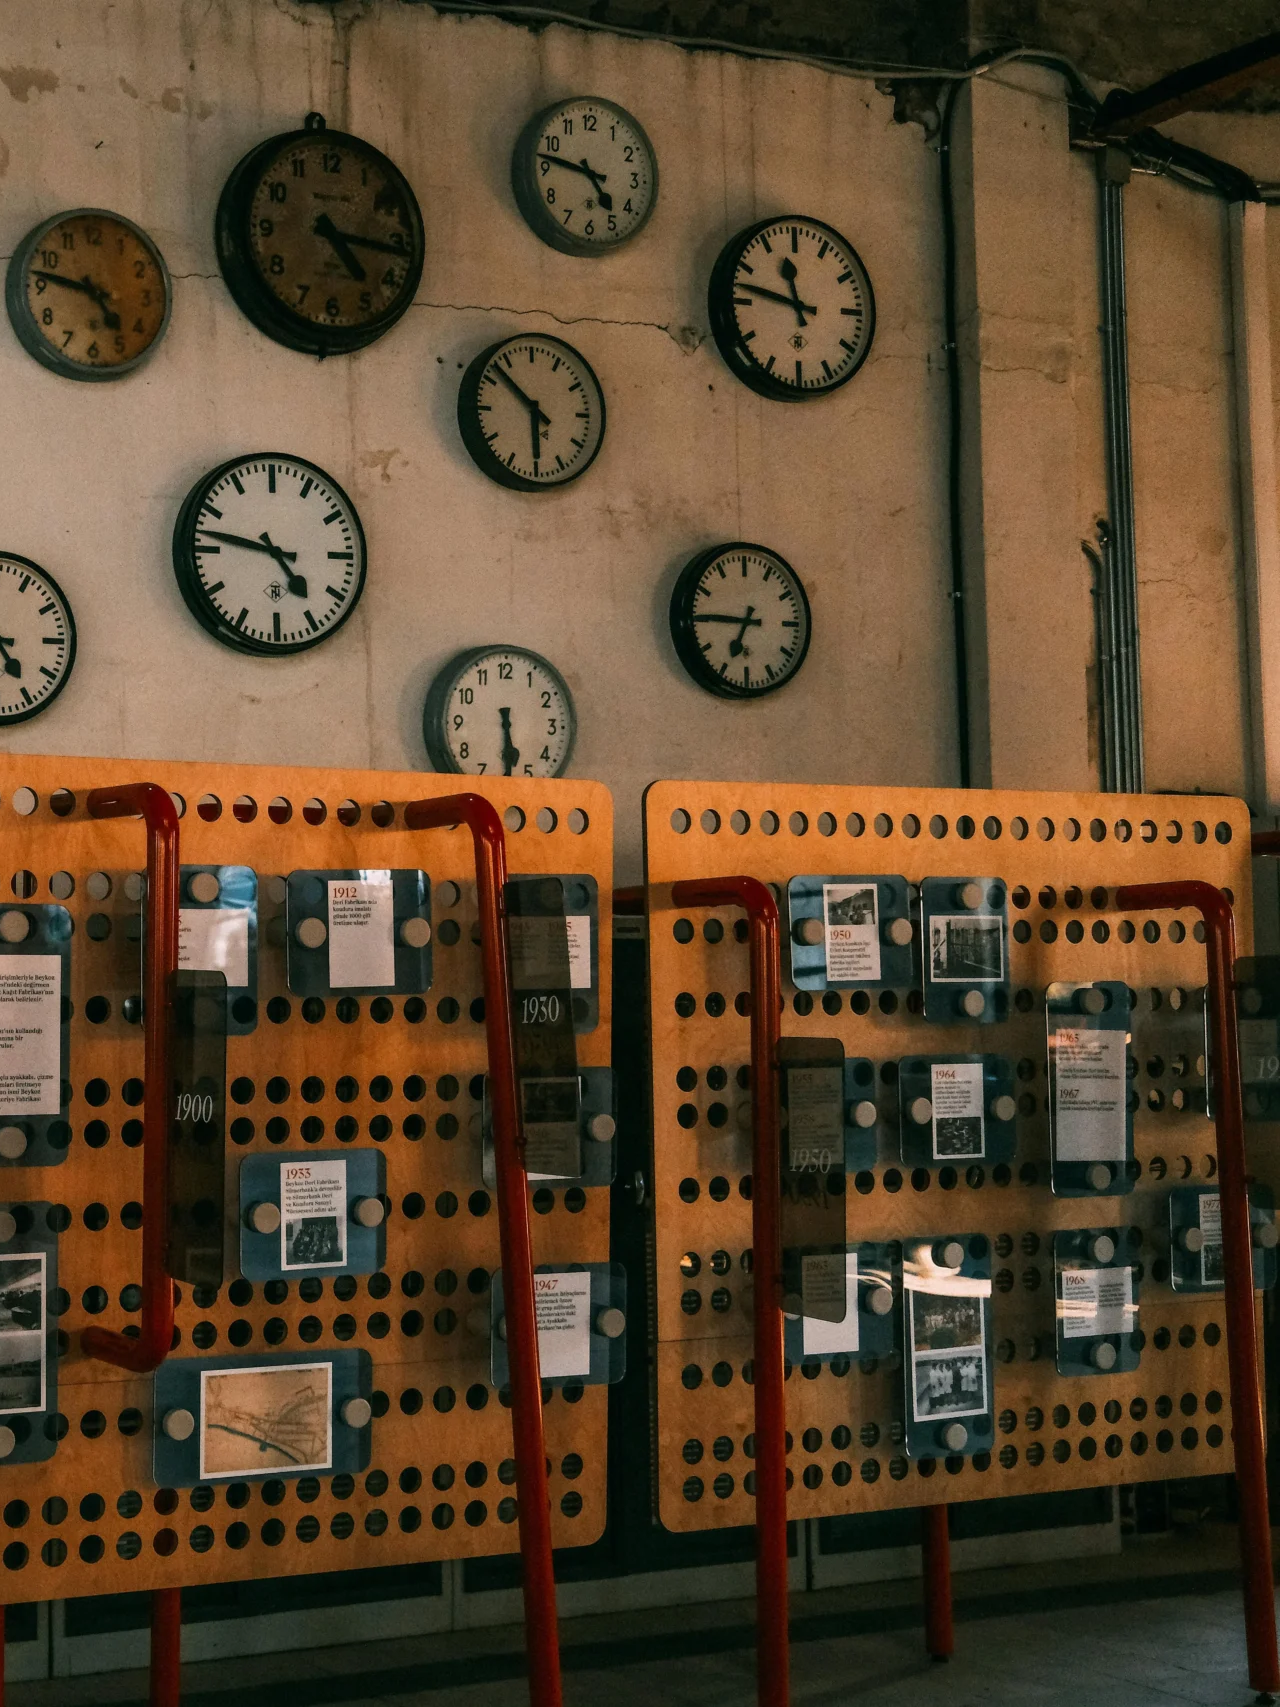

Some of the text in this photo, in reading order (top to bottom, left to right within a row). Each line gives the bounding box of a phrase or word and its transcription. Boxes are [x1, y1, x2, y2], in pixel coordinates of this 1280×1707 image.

[563, 119, 573, 135] 11
[583, 115, 597, 131] 12
[610, 126, 615, 141] 1
[545, 136, 559, 152] 10
[624, 146, 633, 162] 2
[292, 159, 305, 177] 11
[322, 153, 341, 173] 12
[541, 161, 550, 176] 9
[630, 173, 638, 189] 3
[269, 182, 286, 203] 10
[547, 188, 555, 204] 8
[623, 199, 632, 214] 4
[564, 210, 572, 224] 7
[608, 215, 616, 231] 5
[260, 219, 273, 237] 9
[585, 220, 594, 235] 6
[62, 233, 73, 249] 11
[42, 251, 58, 269] 10
[271, 255, 284, 275] 8
[133, 261, 145, 279] 2
[381, 268, 395, 287] 4
[36, 279, 46, 295] 9
[297, 285, 310, 304] 7
[326, 298, 339, 317] 6
[43, 308, 53, 325] 8
[63, 331, 73, 347] 7
[87, 342, 99, 358] 6
[477, 669, 487, 685] 11
[498, 663, 512, 679] 12
[527, 672, 531, 688] 1
[459, 688, 473, 704] 10
[541, 691, 551, 708] 2
[454, 715, 463, 731] 9
[548, 719, 557, 735] 3
[460, 742, 469, 759] 8
[540, 746, 550, 761] 4
[333, 887, 357, 898] 1912
[830, 930, 851, 940] 1950
[522, 995, 560, 1024] 1930
[935, 1070, 955, 1079] 1964
[1258, 1056, 1280, 1079] 19
[1060, 1089, 1079, 1098] 1967
[175, 1093, 213, 1124] 1900
[790, 1148, 832, 1174] 1950
[286, 1168, 311, 1179] 1933
[535, 1280, 558, 1290] 1947
